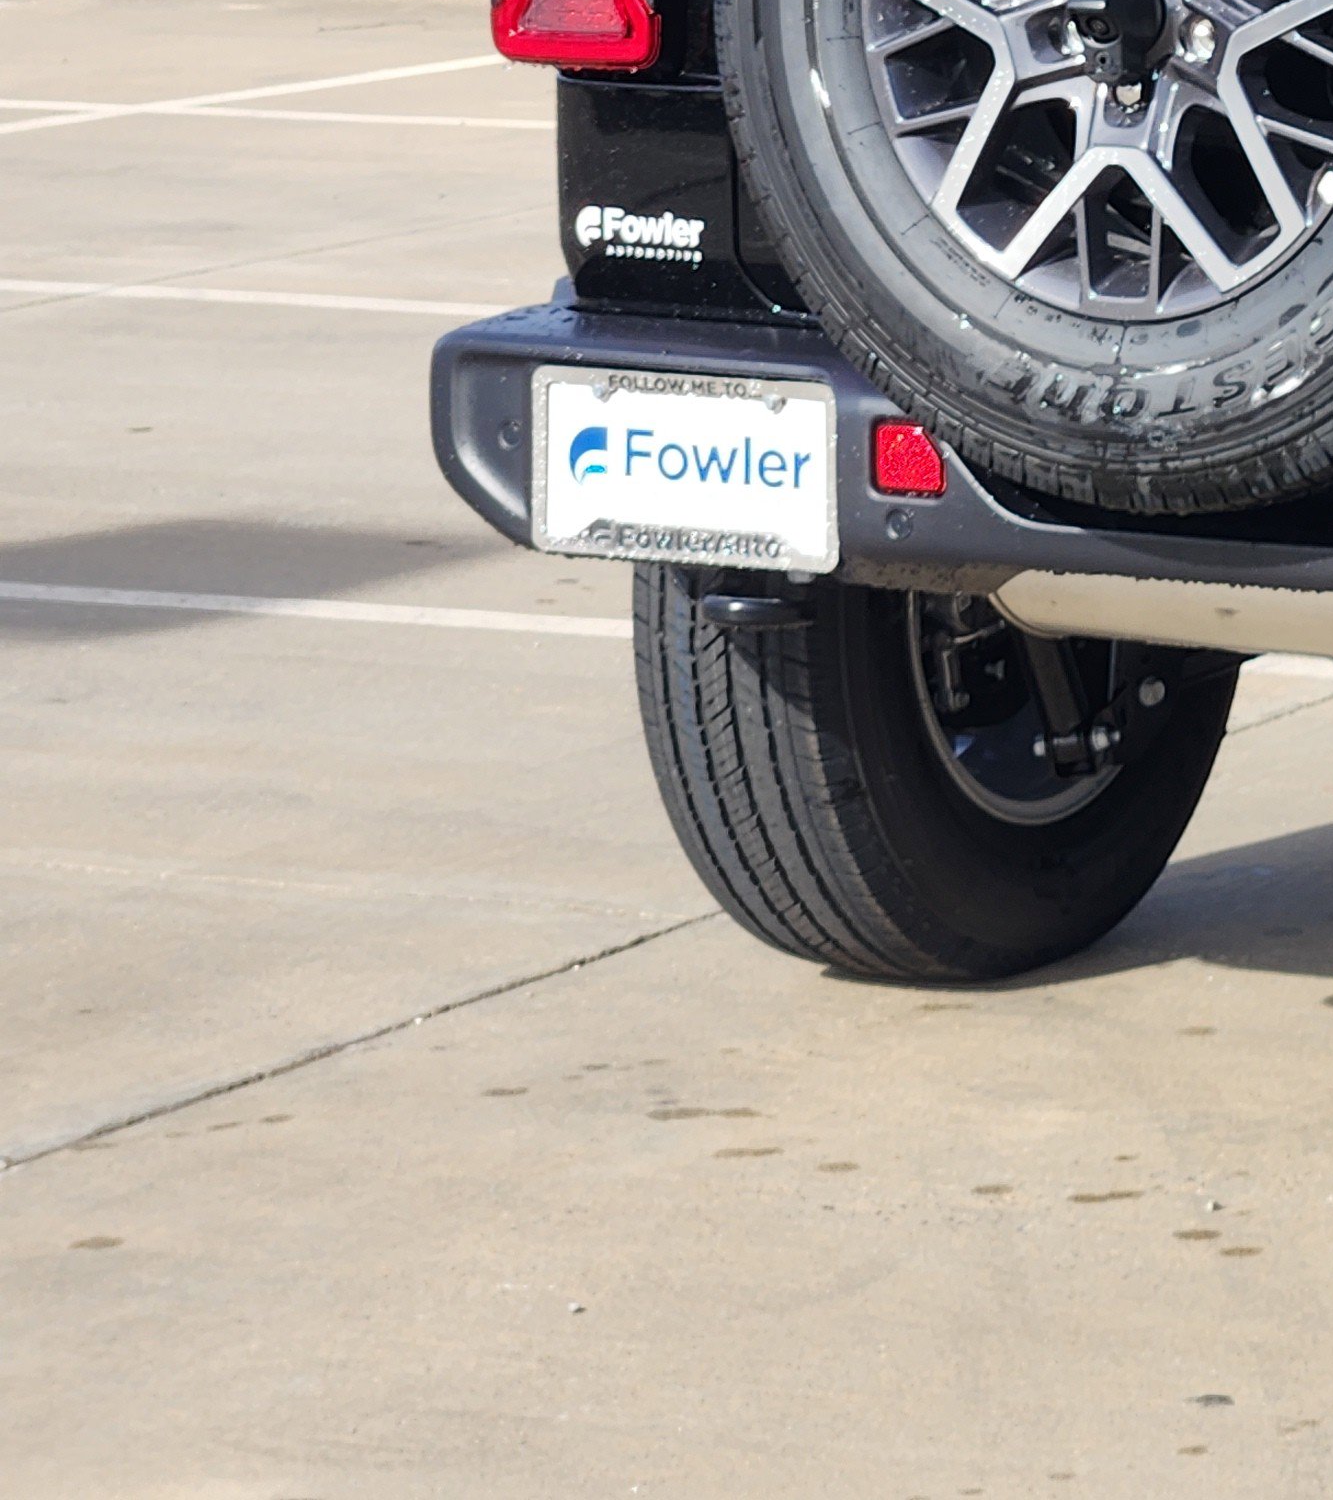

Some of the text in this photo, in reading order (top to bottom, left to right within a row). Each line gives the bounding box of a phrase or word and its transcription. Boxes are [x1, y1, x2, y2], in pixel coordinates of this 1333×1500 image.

[603, 206, 705, 248] Fowler
[608, 373, 685, 392] FOLLOW
[690, 380, 717, 396] ME
[625, 428, 811, 489] Fowler
